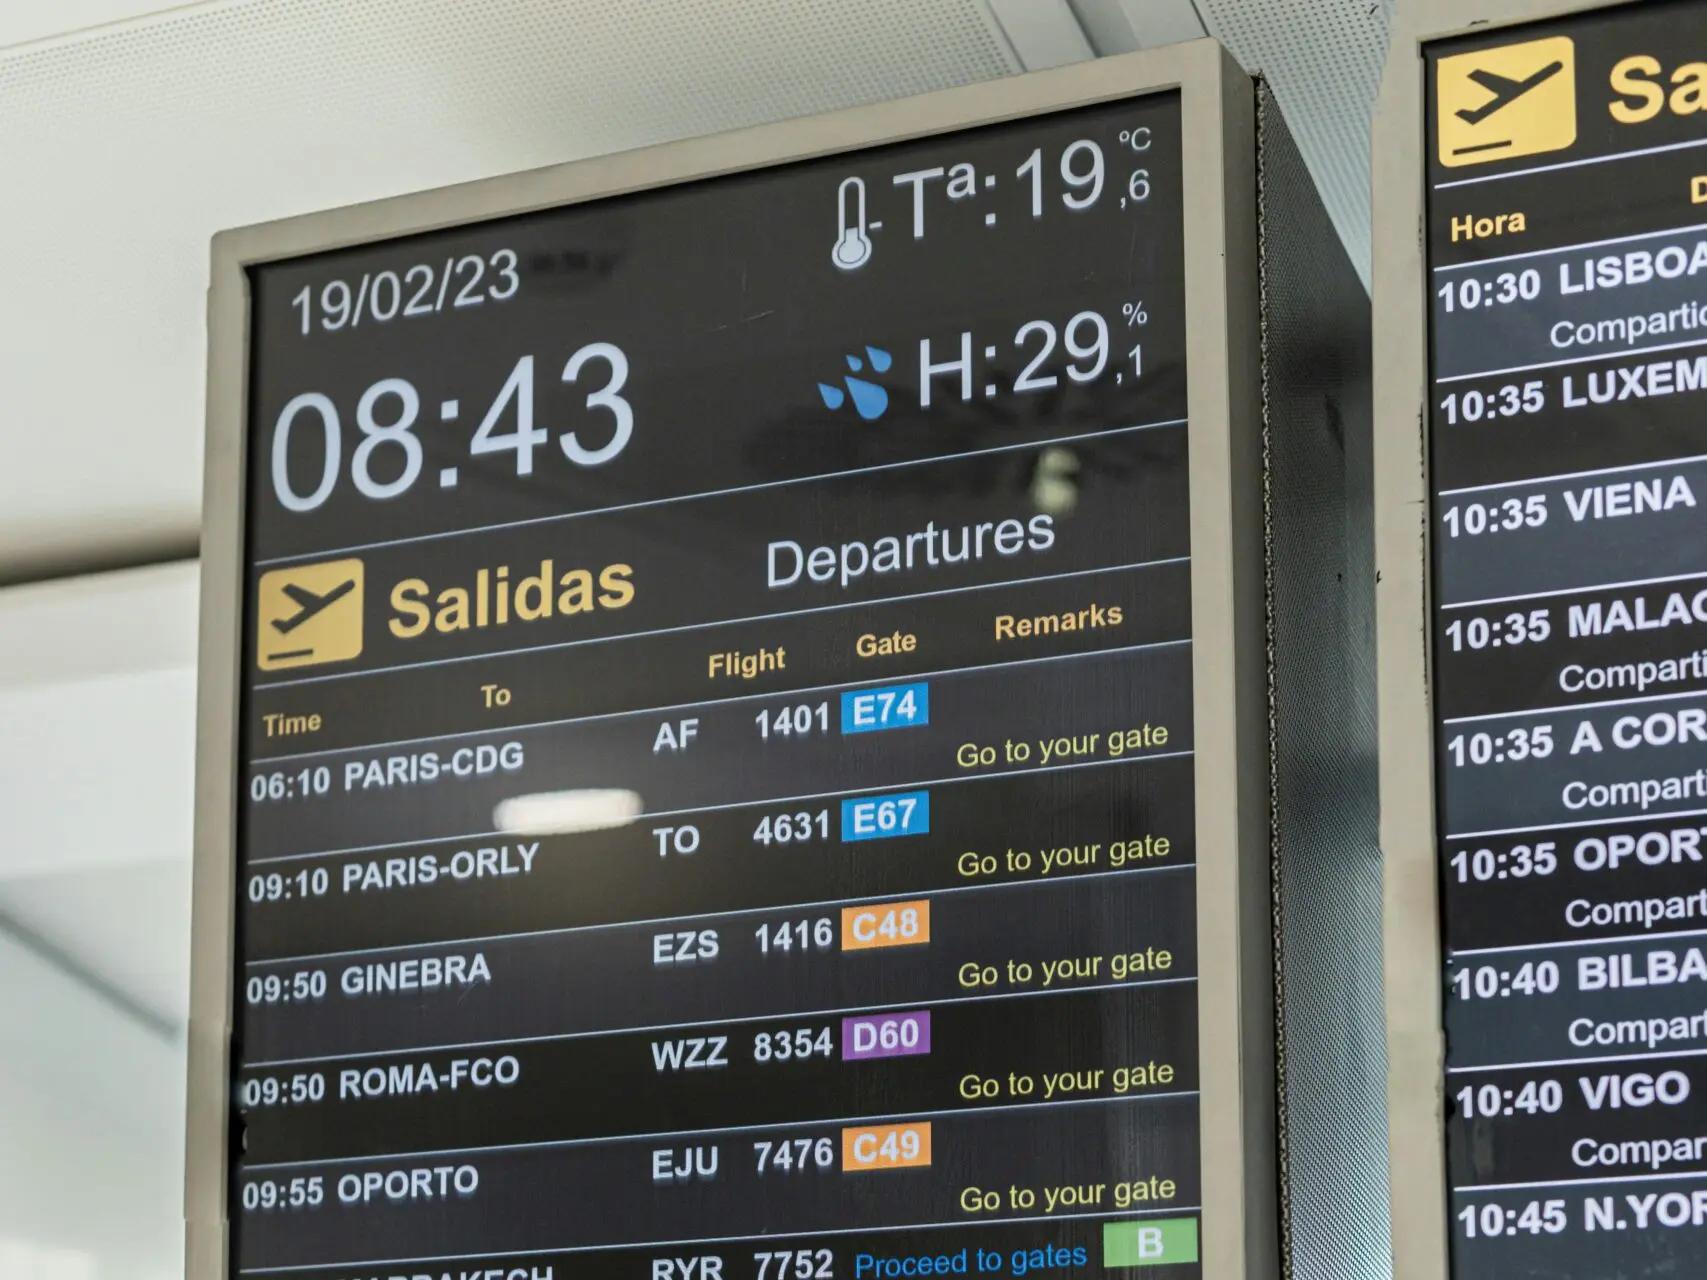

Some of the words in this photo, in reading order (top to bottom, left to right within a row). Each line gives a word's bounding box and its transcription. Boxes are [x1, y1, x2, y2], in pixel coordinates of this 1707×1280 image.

[1451, 211, 1526, 242] Hora
[292, 249, 520, 334] 19/02/23
[1122, 302, 1148, 325] %
[1438, 270, 1540, 312] 10:30
[1440, 381, 1544, 425] 10:35
[271, 343, 634, 512] 08:43
[1443, 495, 1547, 537] 10:35
[1563, 476, 1696, 521] VIENA
[389, 559, 635, 638] Salidas
[768, 512, 1055, 588] Departures
[1445, 610, 1550, 651] 10:35
[263, 713, 321, 736] Time
[481, 685, 511, 708] To
[708, 648, 785, 679] Flight
[856, 632, 916, 657] Gate
[994, 605, 1123, 640] Remarks
[251, 767, 330, 801] 06:10
[345, 742, 523, 790] PARIS-CDG
[653, 719, 698, 751] AF
[755, 702, 828, 738] 1401
[853, 691, 916, 725] E74
[957, 744, 996, 767] Go
[1006, 740, 1030, 762] to
[1040, 734, 1099, 763] your
[1108, 724, 1168, 756] gate
[1448, 725, 1553, 766] 10:35
[249, 869, 328, 902] 09:10
[343, 843, 540, 892] PARIS-ORLY
[653, 826, 700, 856] TO
[753, 810, 828, 845] 4631
[854, 799, 917, 833] E67
[1451, 842, 1556, 883] 10:35
[247, 971, 326, 1003] 09:50
[341, 953, 490, 994] GINEBRA
[654, 930, 719, 963] EZS
[755, 918, 832, 952] 1416
[853, 909, 918, 942] C48
[1453, 961, 1559, 1000] 10:40
[246, 1074, 324, 1106] 09:50
[340, 1056, 519, 1098] ROMA-FCO
[652, 1037, 728, 1071] WZZ
[754, 1028, 833, 1061] 8354
[854, 1019, 918, 1052] D60
[1456, 1080, 1562, 1118] 10:40
[1578, 1071, 1690, 1110] VIGO
[243, 1178, 323, 1209] 09:55
[338, 1166, 479, 1201] OPORTO
[653, 1146, 718, 1179] EJU
[754, 1138, 833, 1172] 7476
[854, 1131, 919, 1163] C49
[961, 1187, 1000, 1211] Go
[1010, 1185, 1035, 1208] to
[1045, 1182, 1105, 1211] your
[1115, 1176, 1176, 1207] gate
[1458, 1200, 1566, 1238] 10:45
[856, 1250, 967, 1279] Proceed
[977, 1250, 1001, 1272] to
[1012, 1245, 1087, 1276] gates
[1138, 1228, 1164, 1259] B
